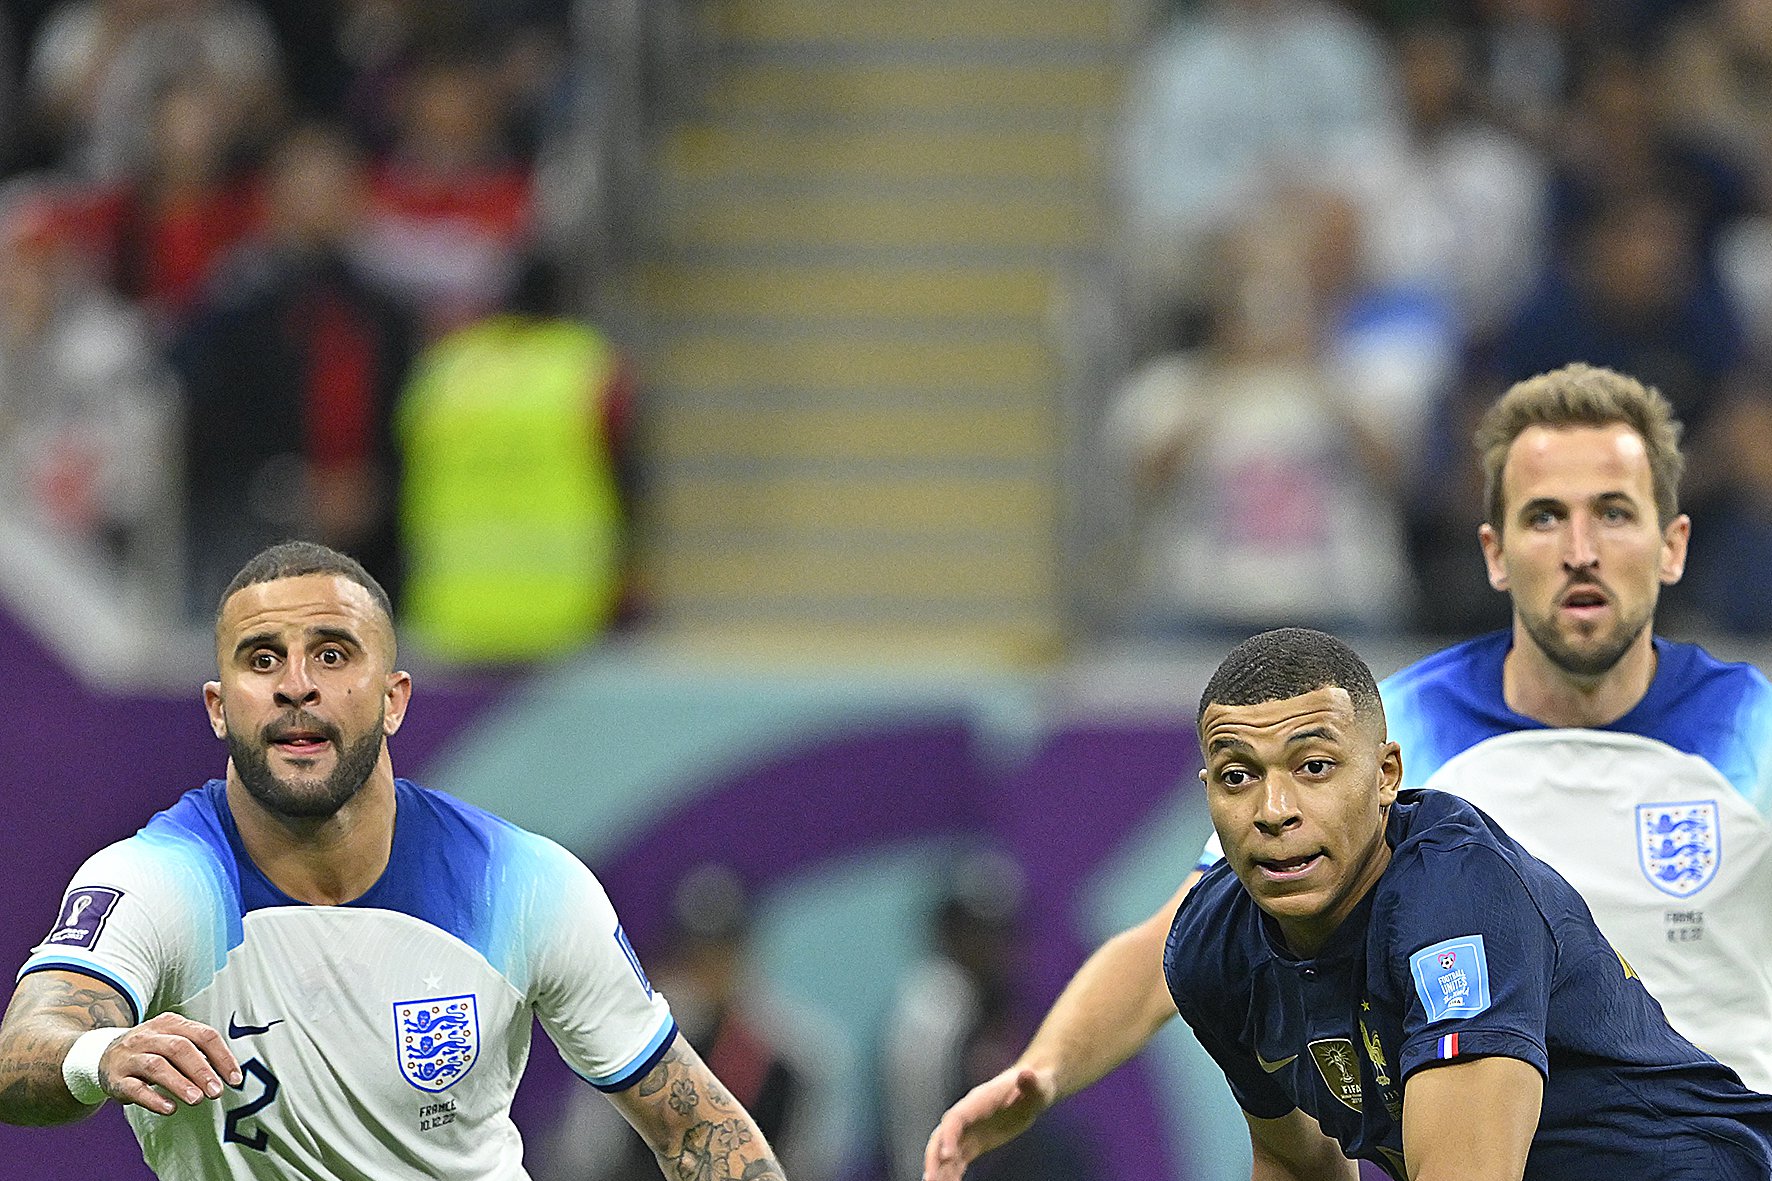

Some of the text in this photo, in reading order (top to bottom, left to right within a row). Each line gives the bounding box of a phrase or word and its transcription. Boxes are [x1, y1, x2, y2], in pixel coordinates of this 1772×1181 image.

[1441, 976, 1468, 995] UNITES
[1341, 1084, 1362, 1094] FIFA
[224, 1057, 280, 1152] 2
[419, 1099, 457, 1118] FRANCE
